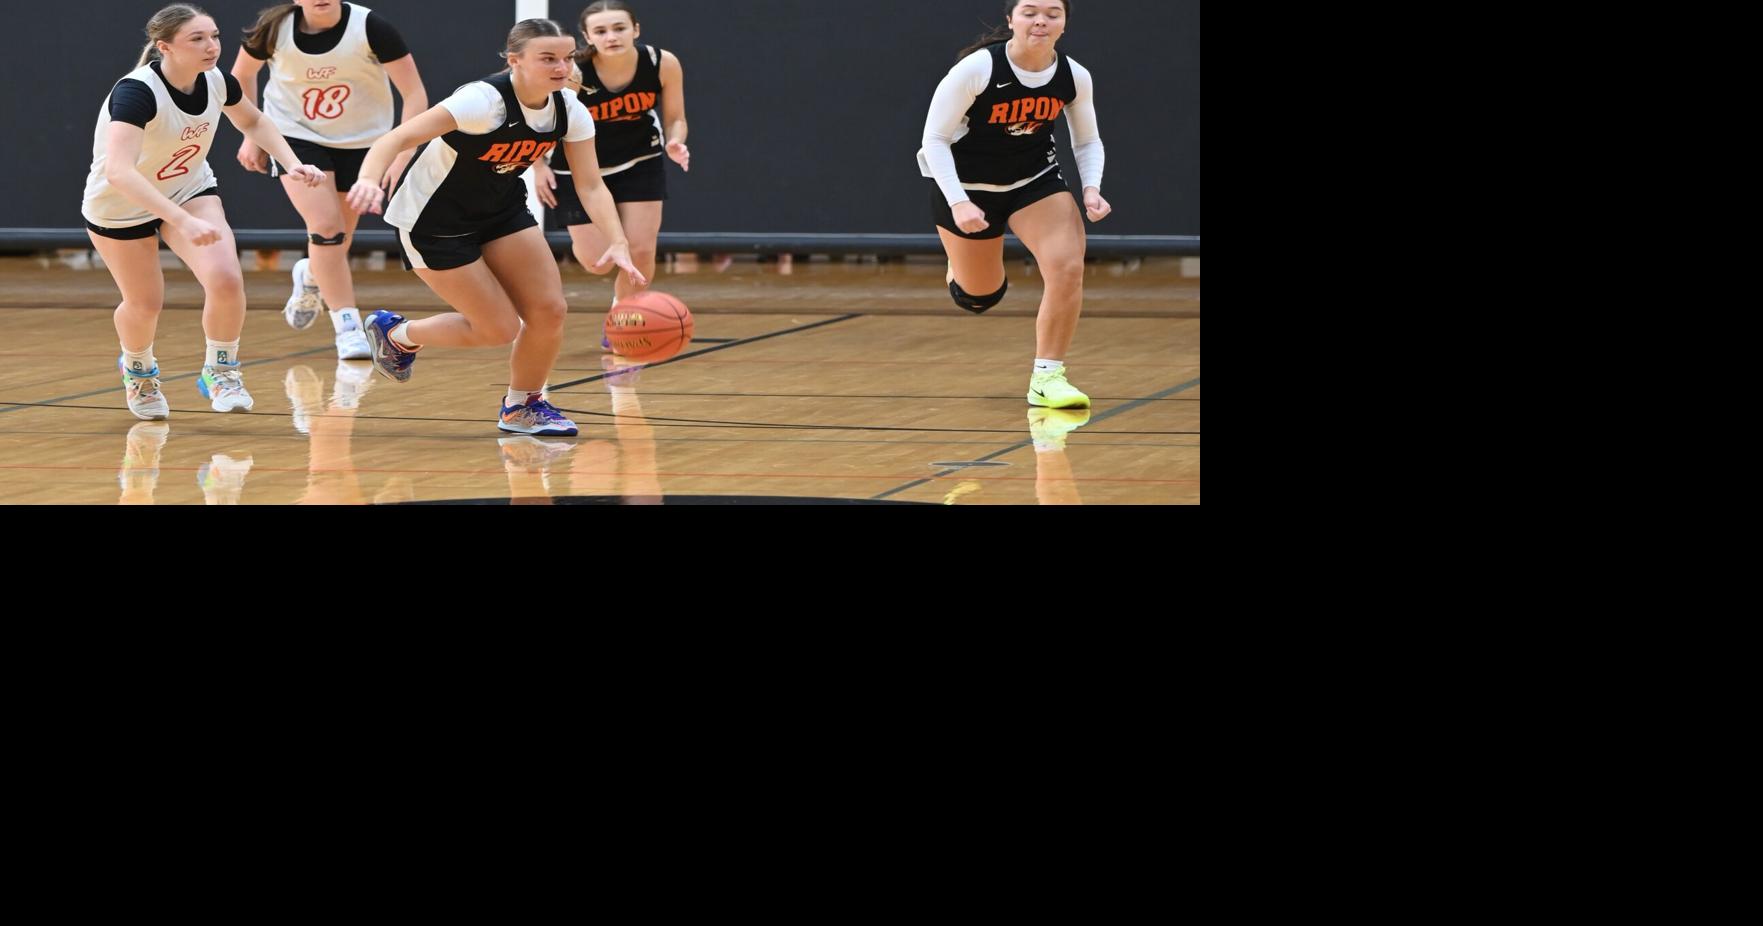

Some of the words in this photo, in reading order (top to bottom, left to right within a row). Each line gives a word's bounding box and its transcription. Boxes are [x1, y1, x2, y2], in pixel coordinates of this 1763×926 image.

[307, 66, 336, 79] WF
[302, 85, 350, 120] 18
[987, 96, 1064, 124] RIPON
[181, 122, 210, 141] WF
[157, 144, 200, 180] 2
[478, 140, 557, 162] RIPO
